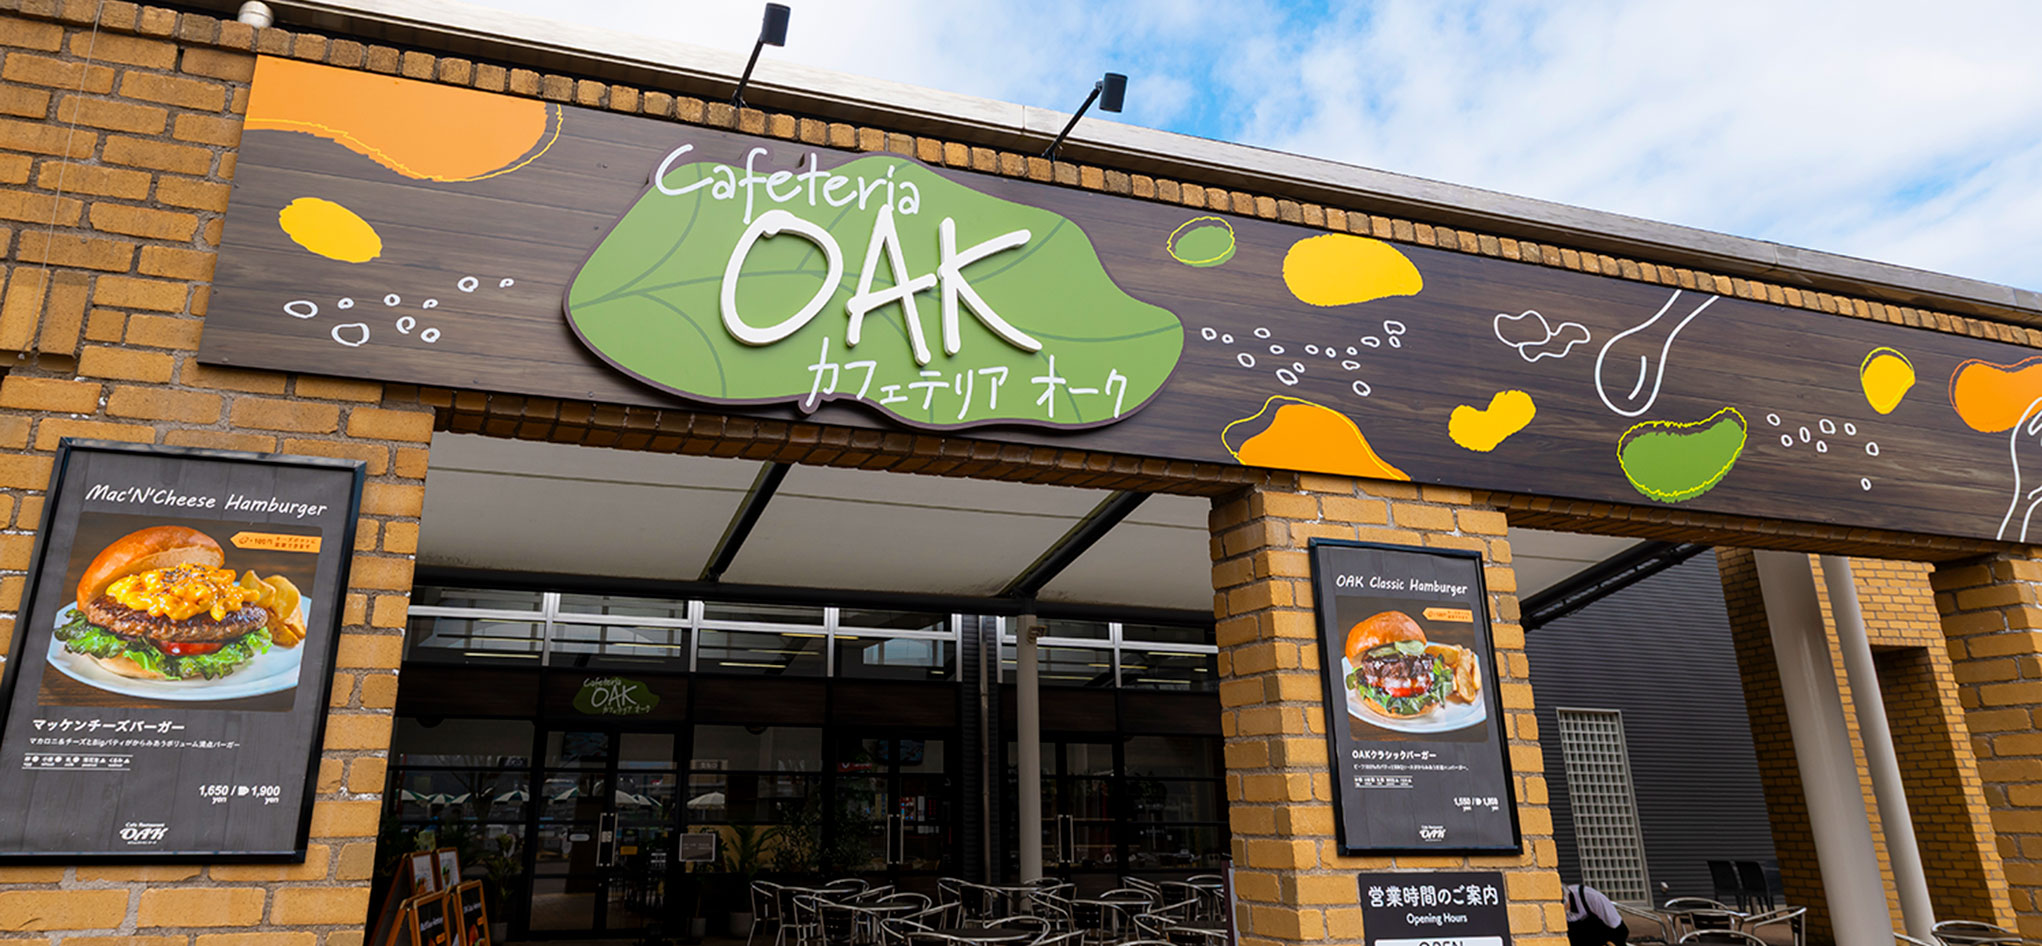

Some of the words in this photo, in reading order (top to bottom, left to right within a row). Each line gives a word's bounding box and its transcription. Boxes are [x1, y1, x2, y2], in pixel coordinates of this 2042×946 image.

[655, 144, 920, 225] Cafeteria
[720, 204, 1043, 366] OAK
[806, 337, 1009, 419] カフェテリア
[1031, 354, 1128, 419] オーク
[85, 484, 216, 508] Mac'N'Cheese
[224, 493, 327, 519] Hamburger
[1335, 574, 1365, 588] OAK
[1369, 576, 1405, 590] Classic
[1409, 578, 1468, 597] Hamburger
[590, 684, 638, 708] OAK
[32, 718, 185, 734] マッケンチーズバーガー
[1352, 749, 1437, 760] OAKクラシックバーガー
[199, 784, 229, 798] 1,650
[251, 785, 281, 798] 1,900
[212, 797, 228, 805] yen
[264, 797, 280, 805] yen
[119, 827, 169, 841] OAK
[1419, 828, 1447, 839] OAK
[1368, 884, 1499, 908] 営業時間のご案内
[1406, 912, 1443, 926] Opening
[1443, 912, 1468, 924] Hours
